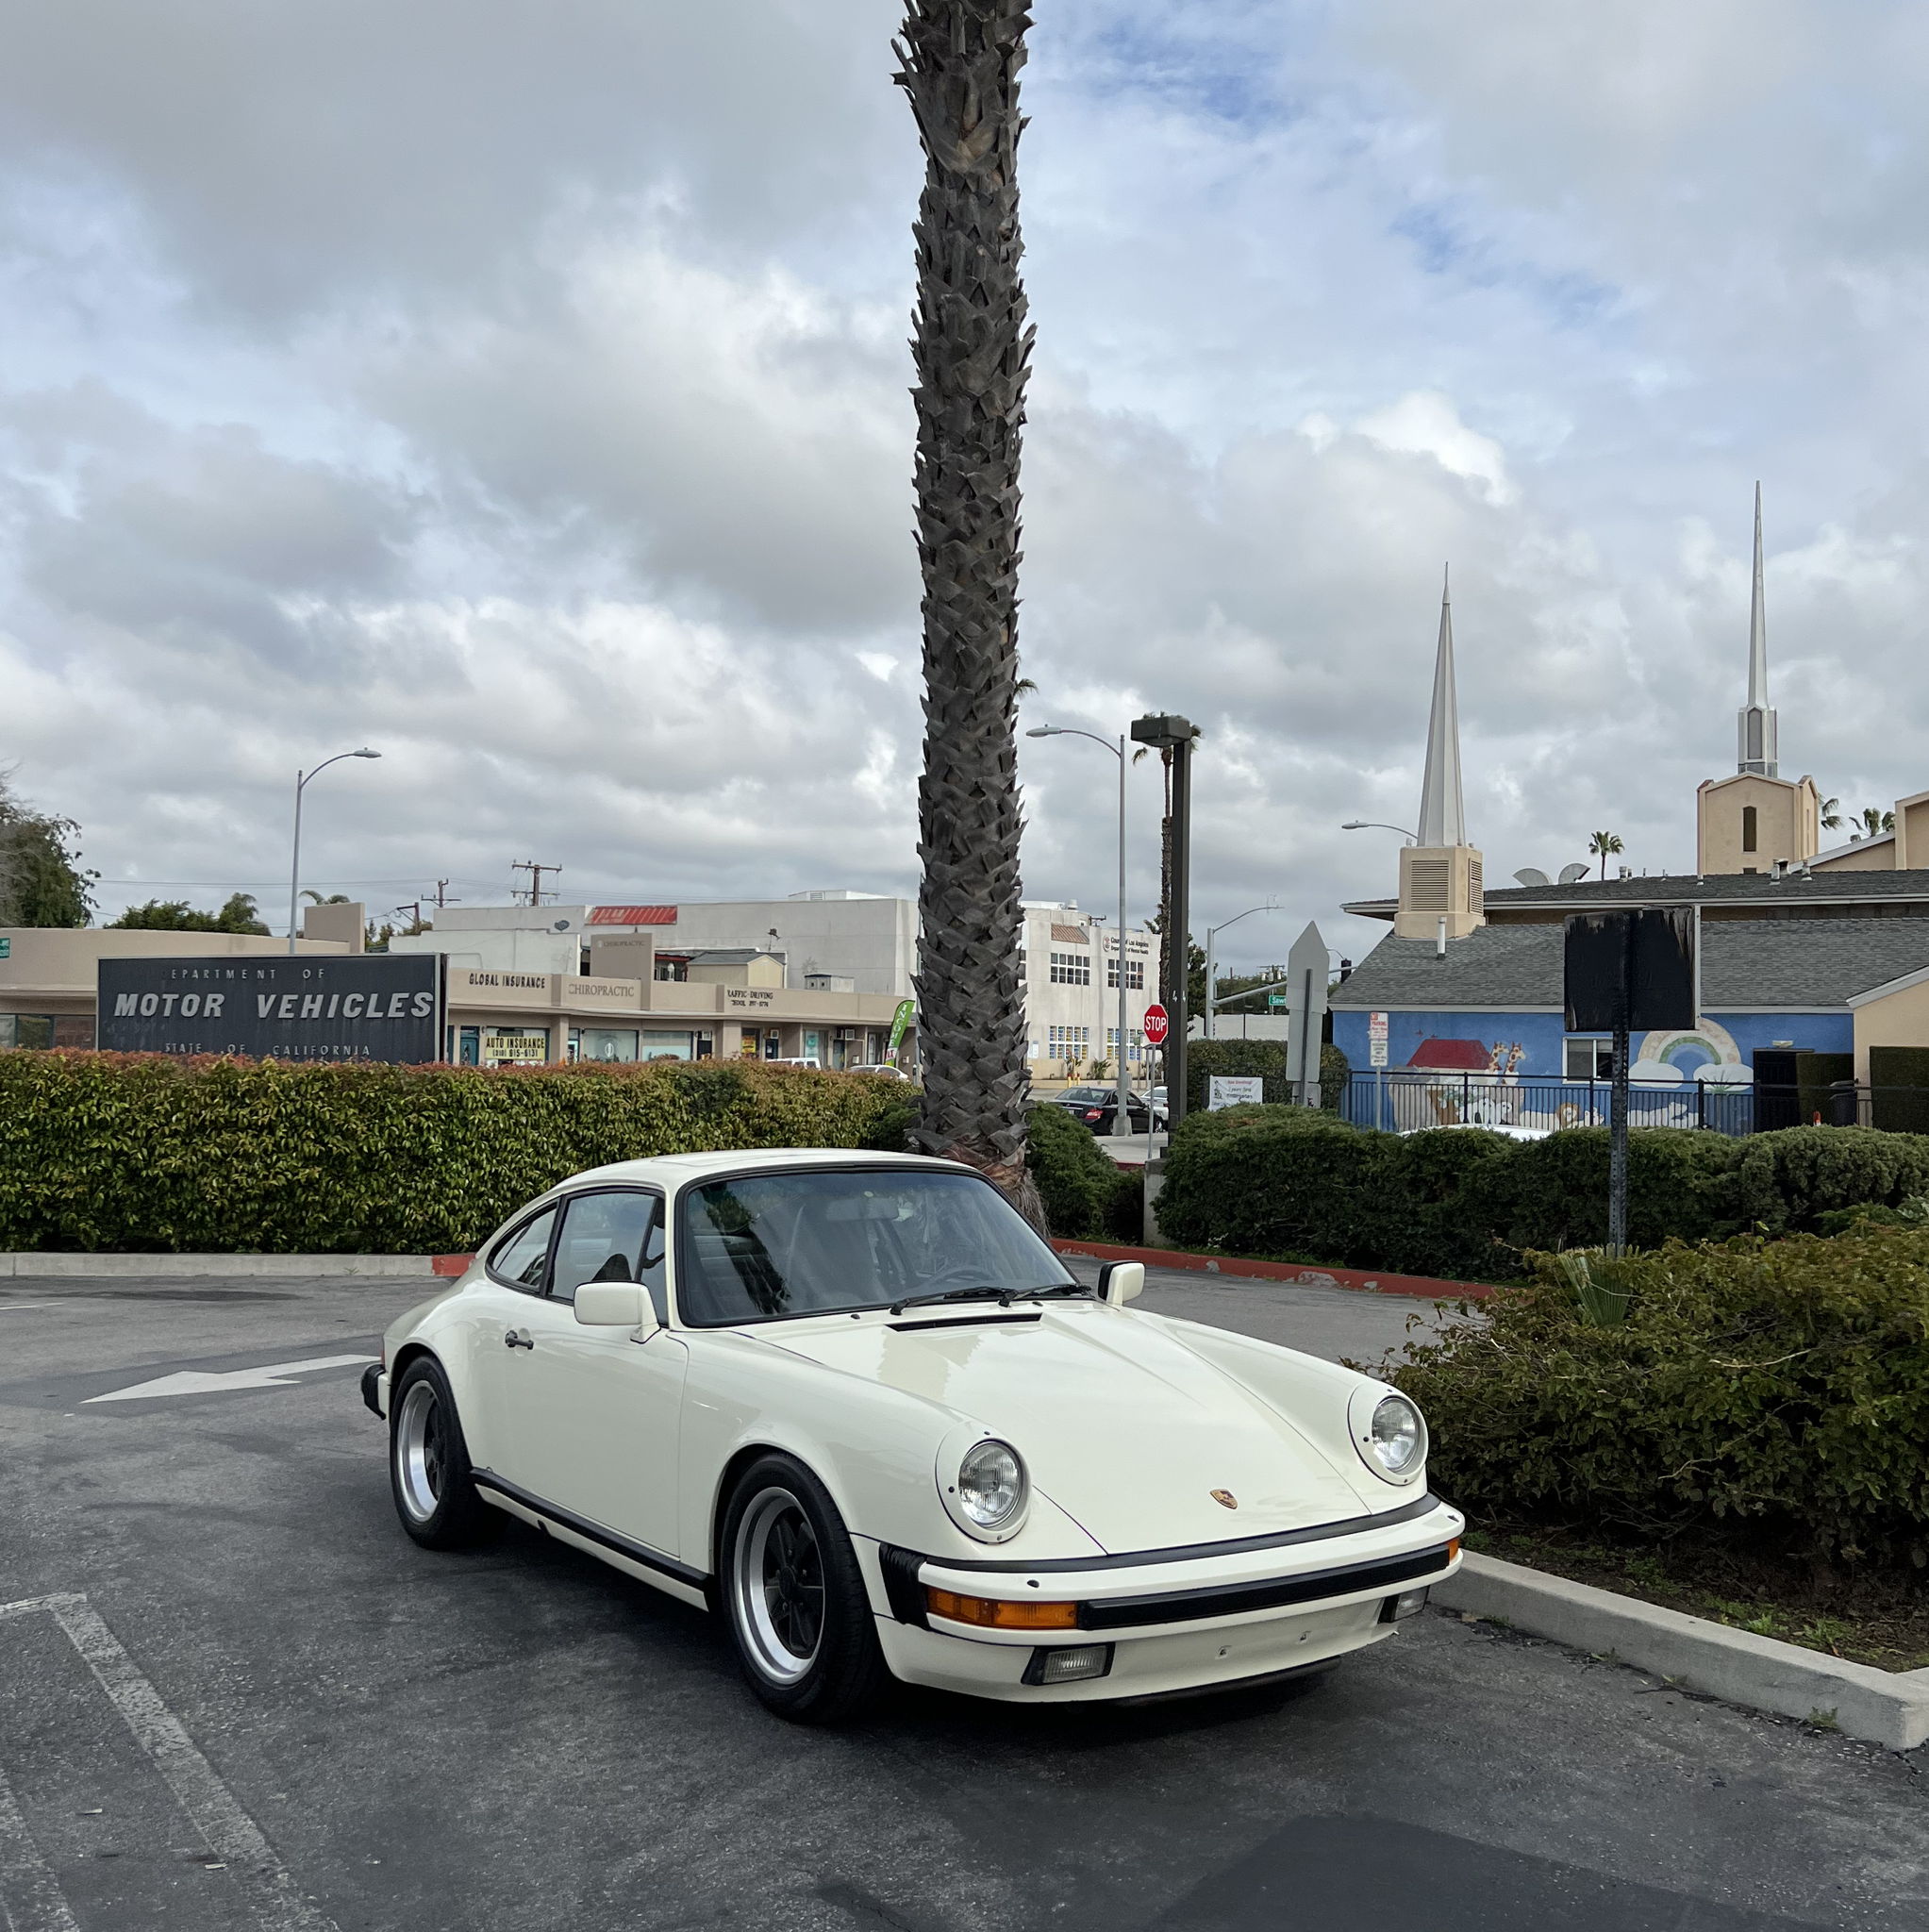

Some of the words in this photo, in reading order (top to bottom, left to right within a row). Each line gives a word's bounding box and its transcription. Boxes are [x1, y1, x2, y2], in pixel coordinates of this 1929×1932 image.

[302, 968, 324, 979] OF
[469, 973, 499, 987] GLOBAL
[502, 974, 546, 990] INSURANCE
[569, 984, 634, 996] CHIROPRACTIC
[1172, 990, 1178, 1002] 4
[114, 993, 224, 1018] MOTOR
[257, 991, 434, 1019] VEHICLES
[1272, 996, 1287, 1005] Sawt
[1145, 1016, 1167, 1031] STOP
[486, 1037, 505, 1049] AUTO
[507, 1037, 544, 1049] INSURANCE
[164, 1043, 202, 1054] STATE
[227, 1043, 245, 1053] OF
[273, 1044, 370, 1056] CALIFORNIA
